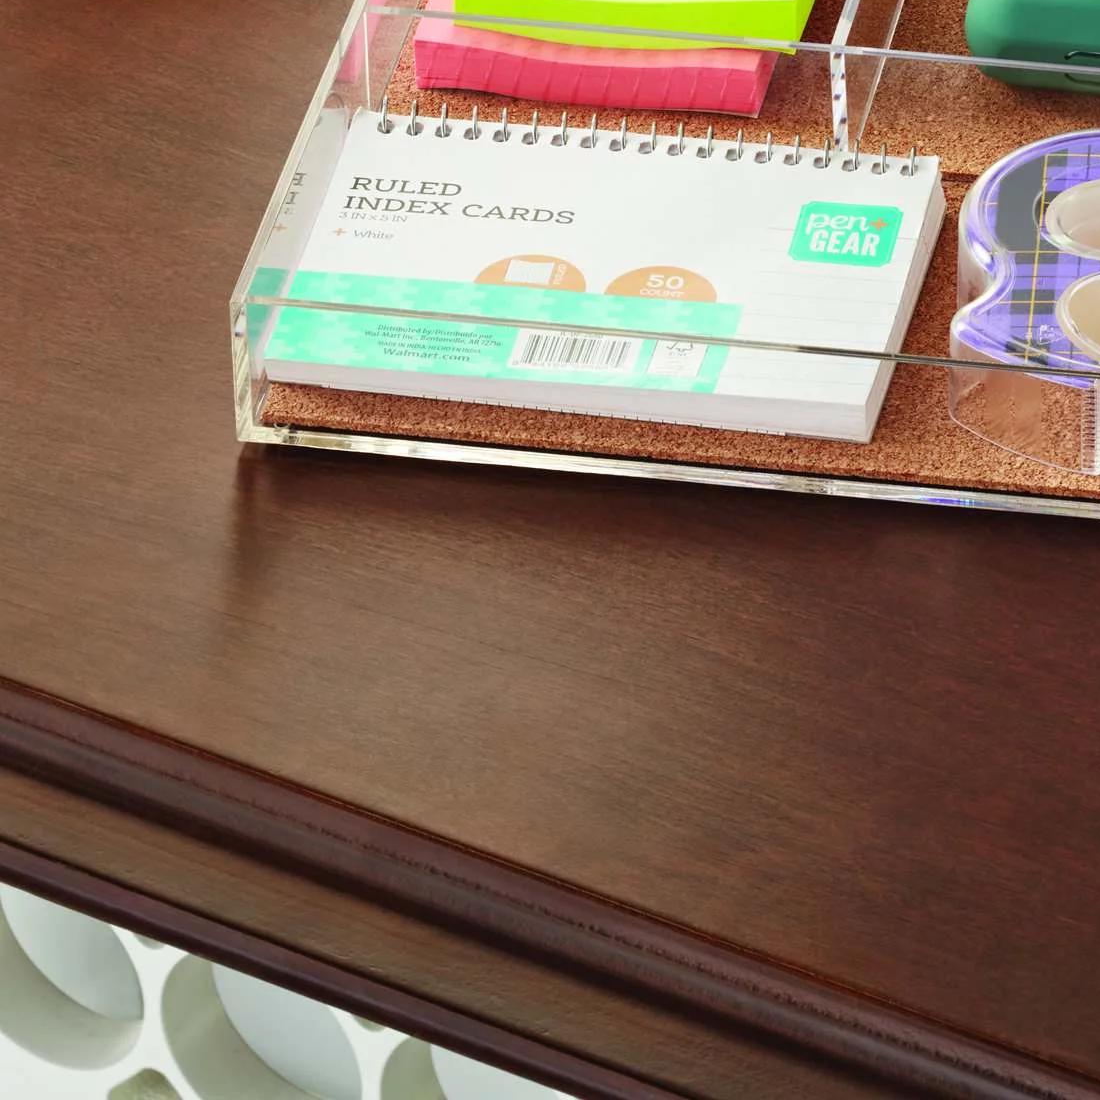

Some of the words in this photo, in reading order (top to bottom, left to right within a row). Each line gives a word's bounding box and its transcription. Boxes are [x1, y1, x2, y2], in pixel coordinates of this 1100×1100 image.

[350, 176, 462, 197] RULED
[343, 195, 452, 215] INDEX
[462, 203, 576, 224] CARDS
[353, 228, 395, 239] White
[809, 230, 880, 257] GEAR
[646, 274, 685, 291] 50
[383, 348, 471, 362] Walmart.com
